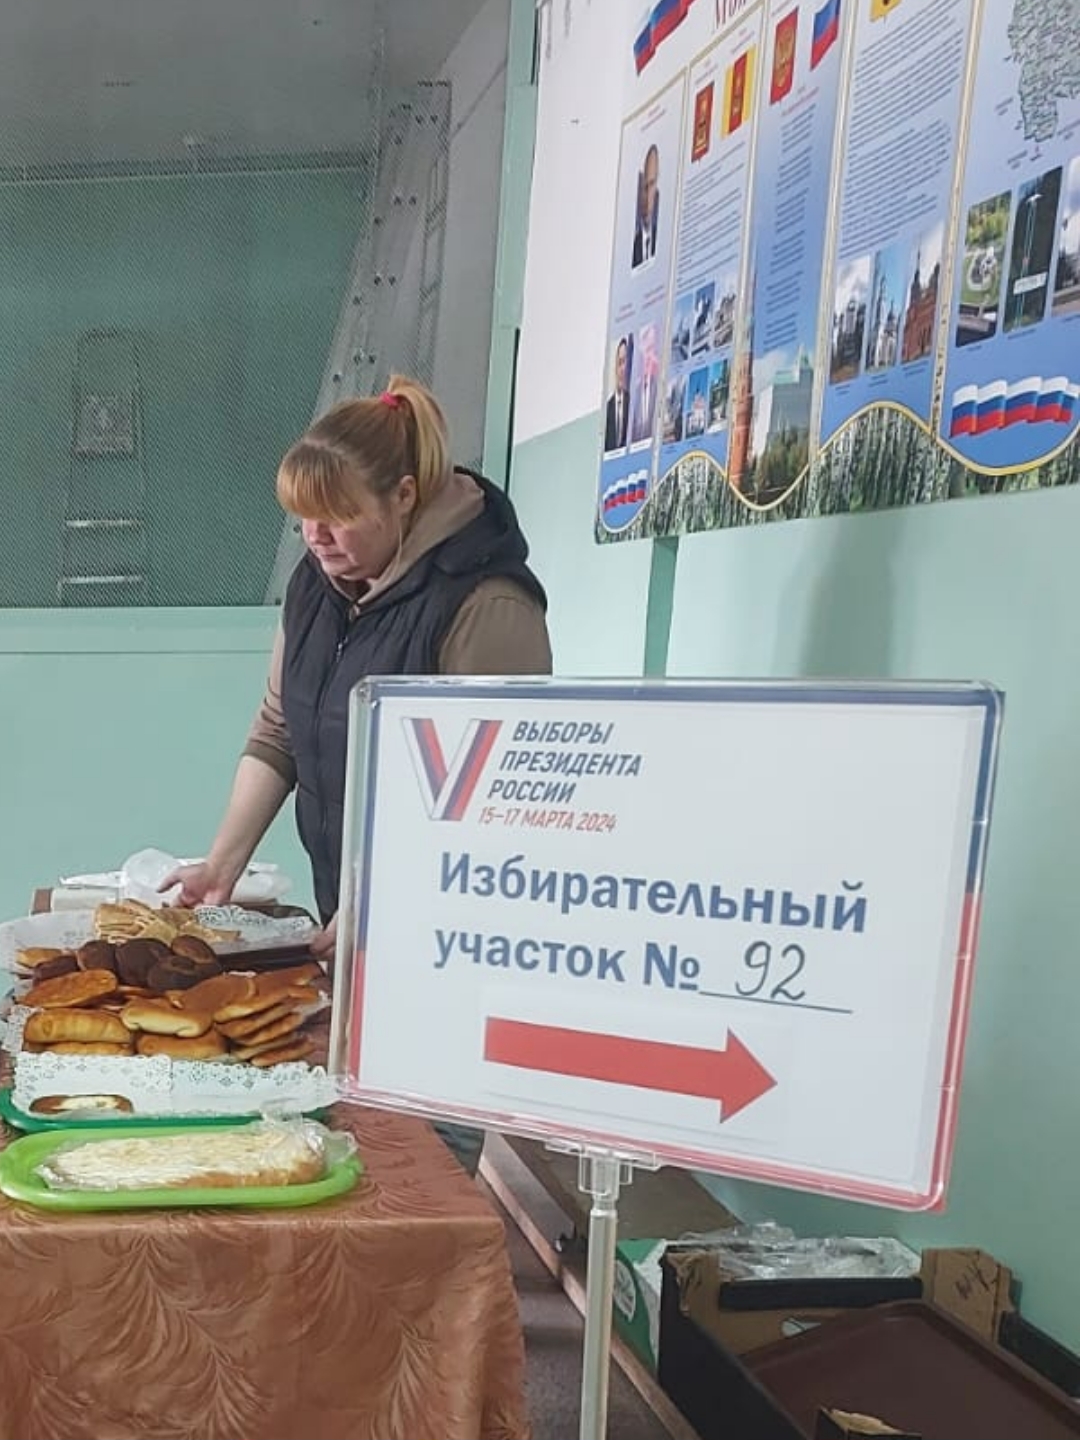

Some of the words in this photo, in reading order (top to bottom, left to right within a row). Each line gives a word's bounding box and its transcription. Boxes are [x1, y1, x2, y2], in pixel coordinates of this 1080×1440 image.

[512, 720, 614, 744] ВЫБОРЫ
[499, 750, 642, 776] ПРЕЗИДЕНТА
[487, 779, 577, 803] РОССИИ
[521, 811, 573, 830] МАРТА
[575, 812, 617, 833] 2024
[440, 851, 867, 933] Избирательный
[433, 928, 626, 983] участок
[643, 941, 700, 991] №
[735, 940, 806, 1001] 92
